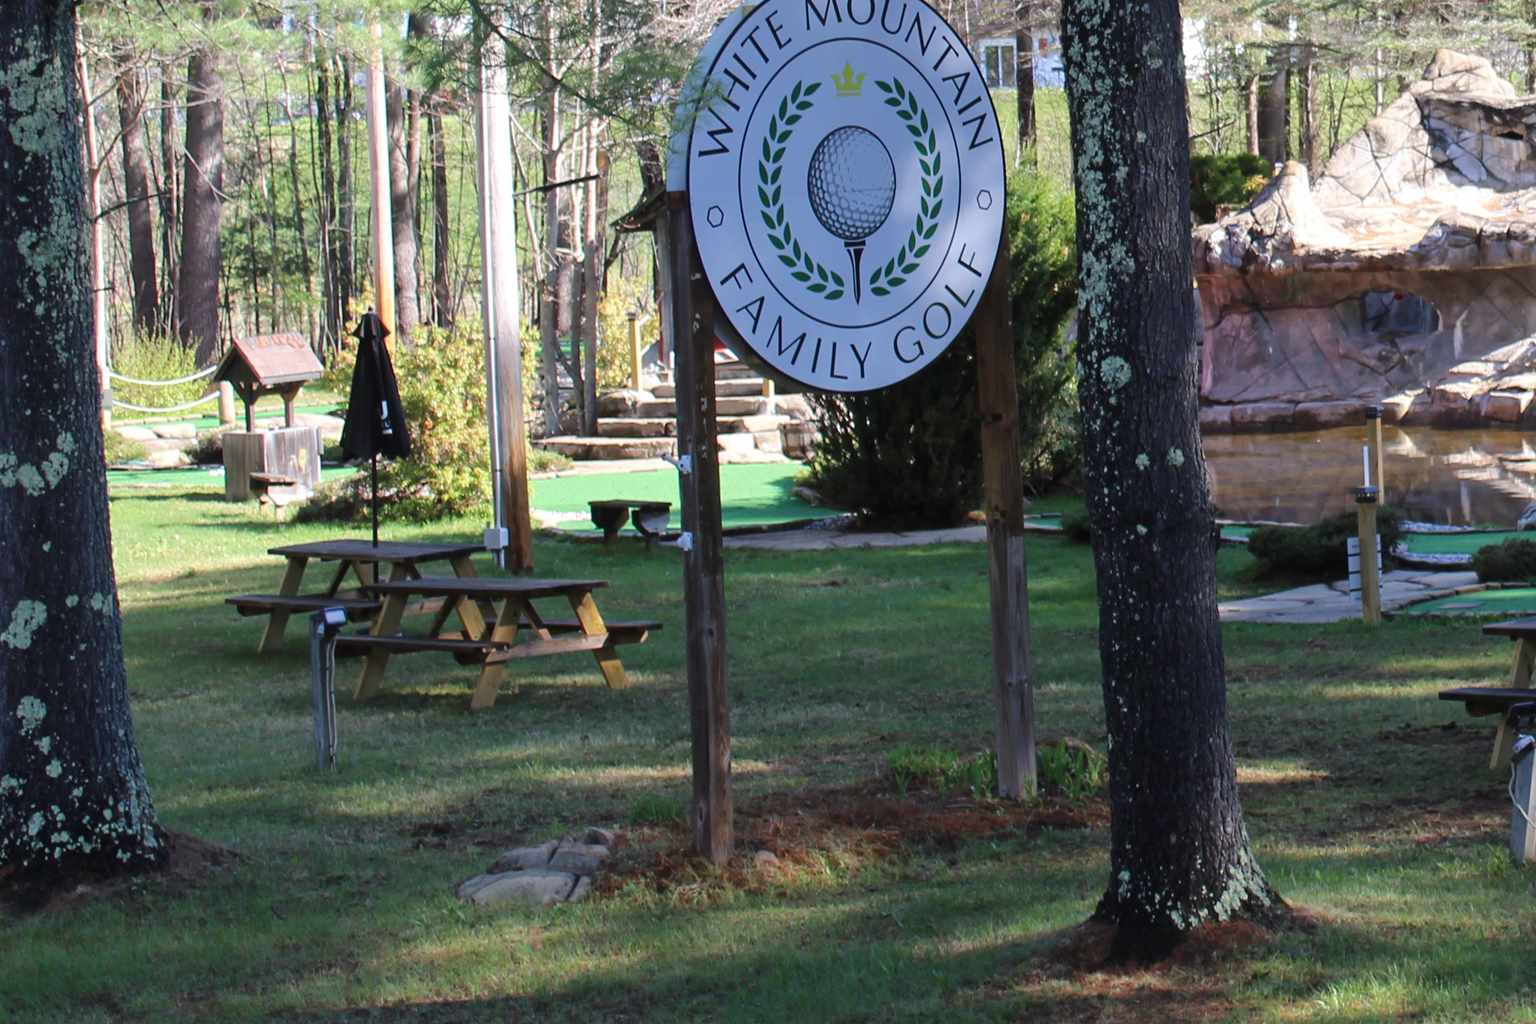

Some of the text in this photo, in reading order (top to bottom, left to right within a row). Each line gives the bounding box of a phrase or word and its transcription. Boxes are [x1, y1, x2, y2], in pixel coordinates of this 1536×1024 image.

[698, 10, 792, 158] WHITE
[719, 243, 983, 380] FAMILY GOLF
